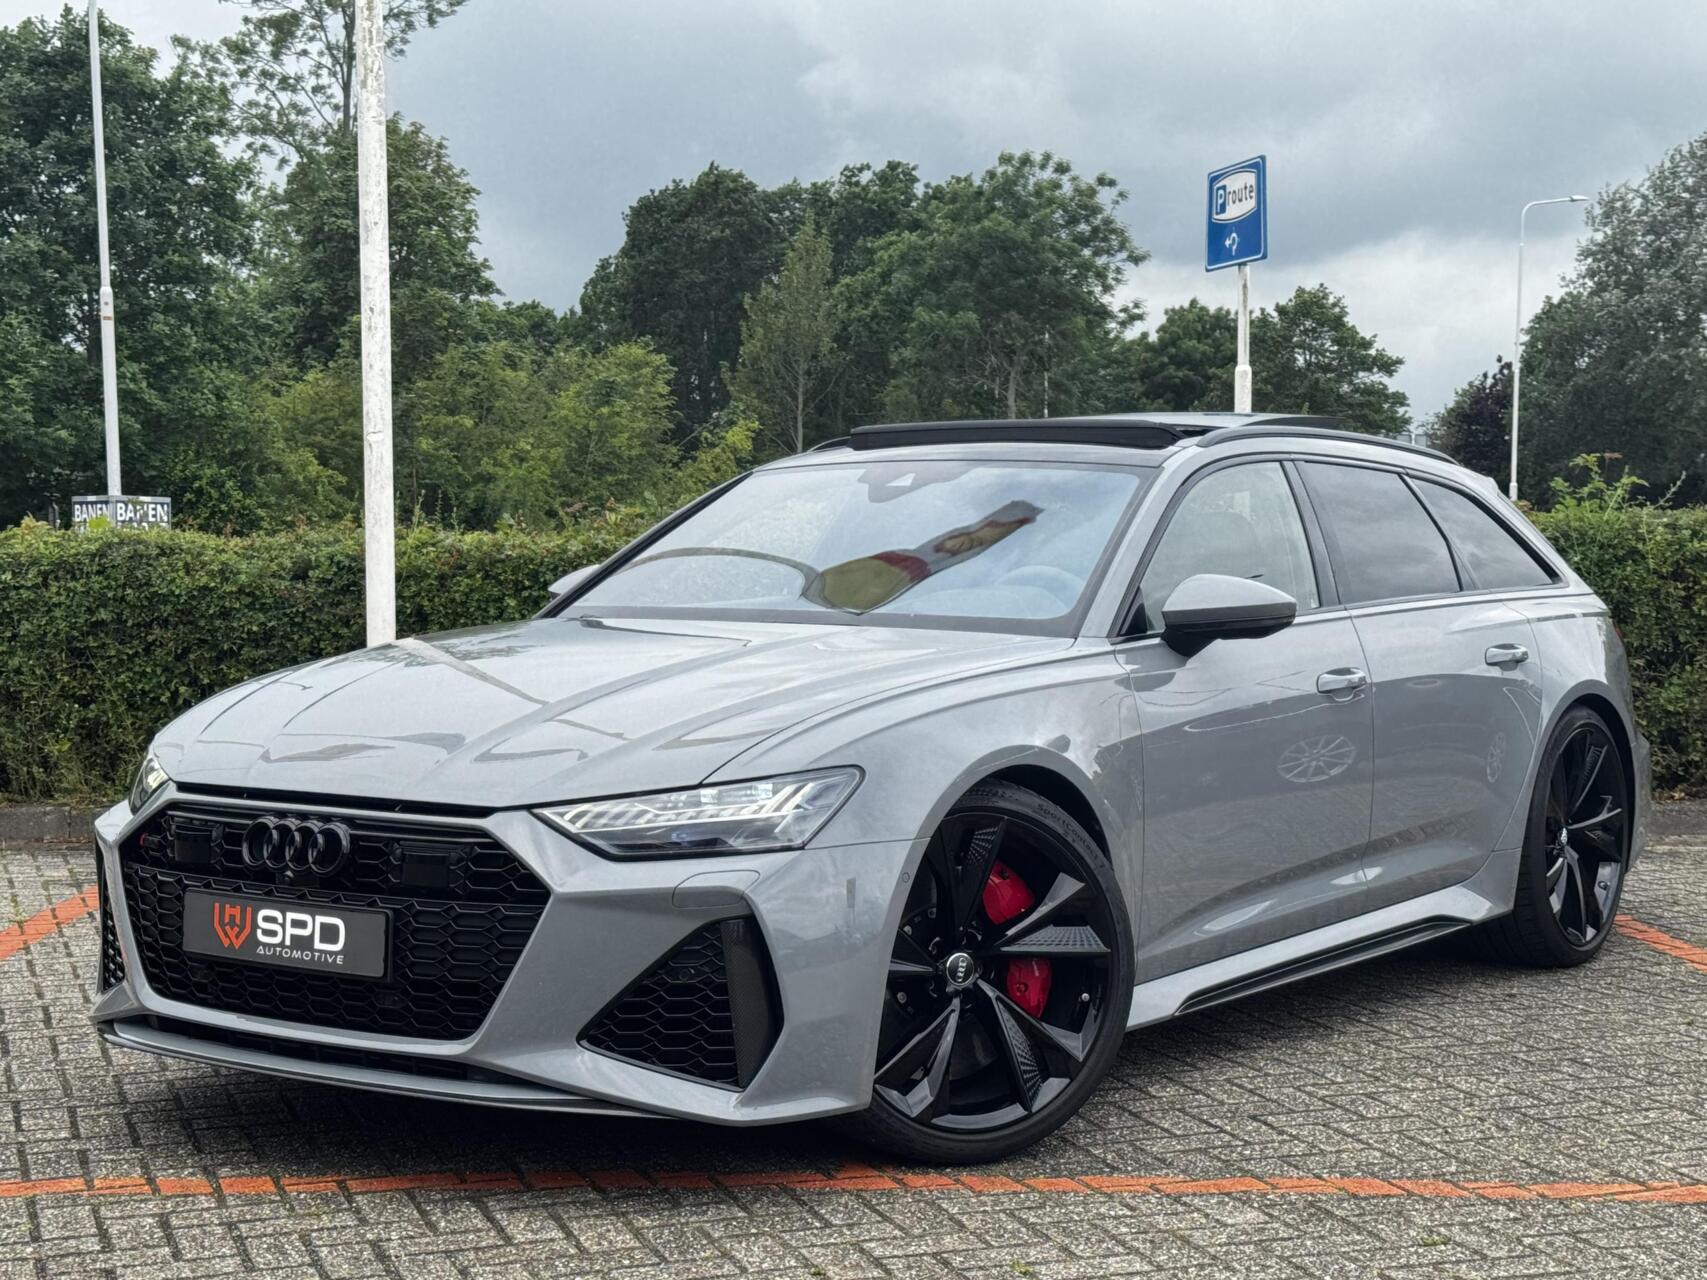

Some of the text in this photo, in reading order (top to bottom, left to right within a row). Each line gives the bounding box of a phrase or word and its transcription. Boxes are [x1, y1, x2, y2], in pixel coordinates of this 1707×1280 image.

[1227, 181, 1254, 206] route
[74, 503, 110, 522] BANEN
[256, 908, 346, 952] SPD
[256, 945, 345, 965] AUTOMOTIVE
